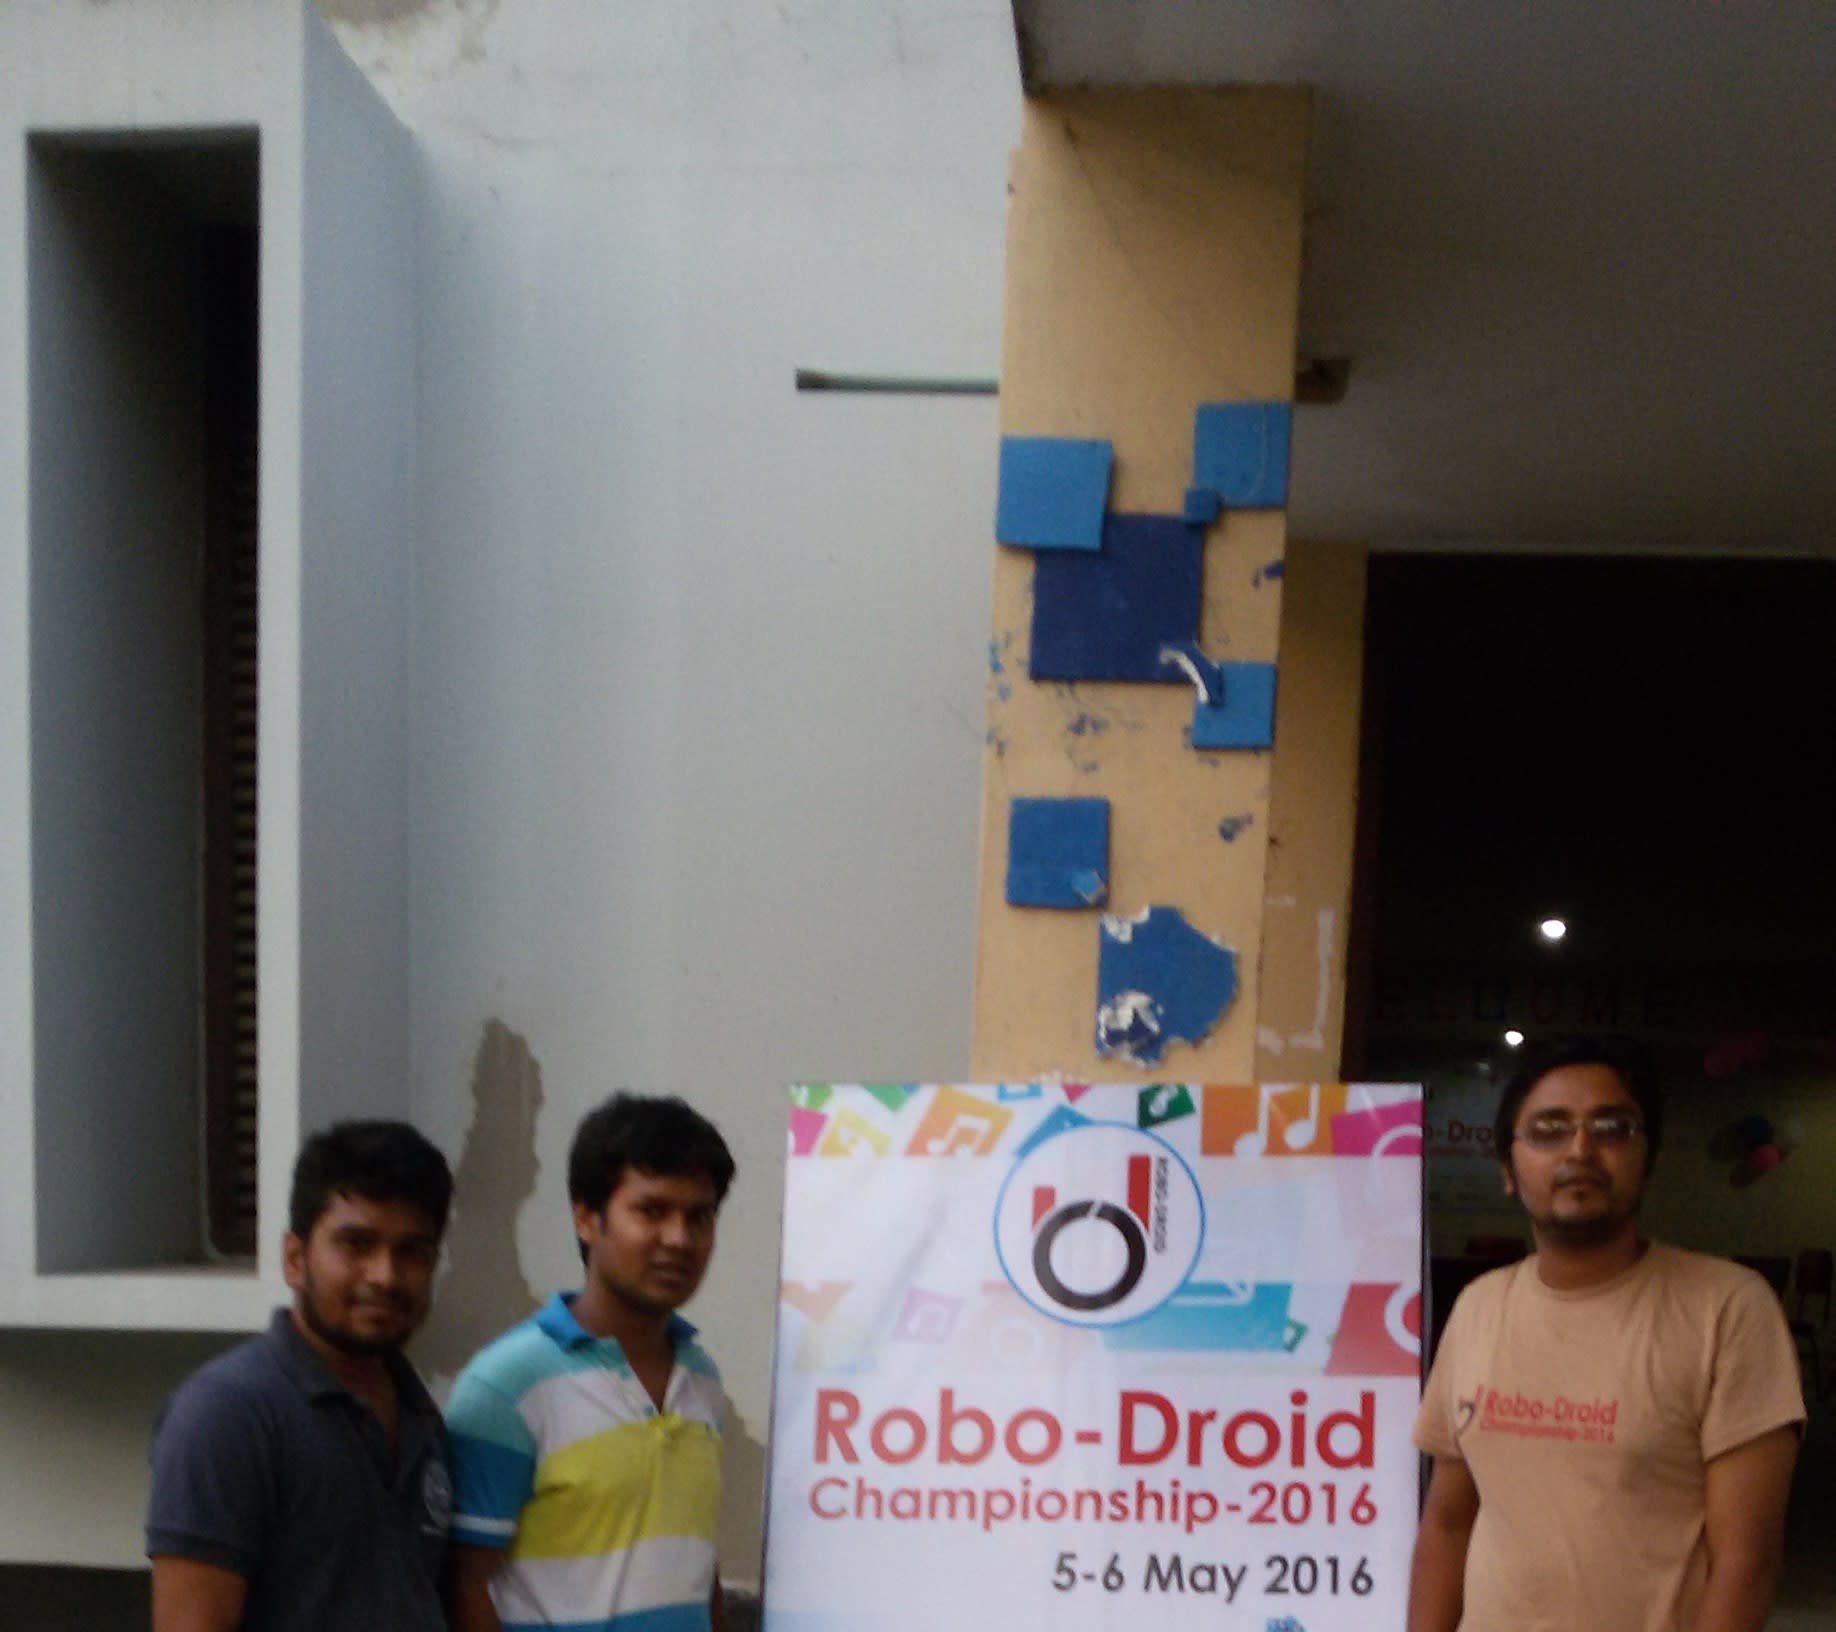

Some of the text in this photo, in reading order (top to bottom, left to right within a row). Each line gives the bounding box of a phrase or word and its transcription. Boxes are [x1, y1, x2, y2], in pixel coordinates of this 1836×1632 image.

[813, 1388, 1377, 1470] Robo-Droid
[1485, 1388, 1618, 1425] Robo-Droid
[809, 1477, 1378, 1534] Championship-2016
[1052, 1552, 1374, 1604] 5-6 May 2016
